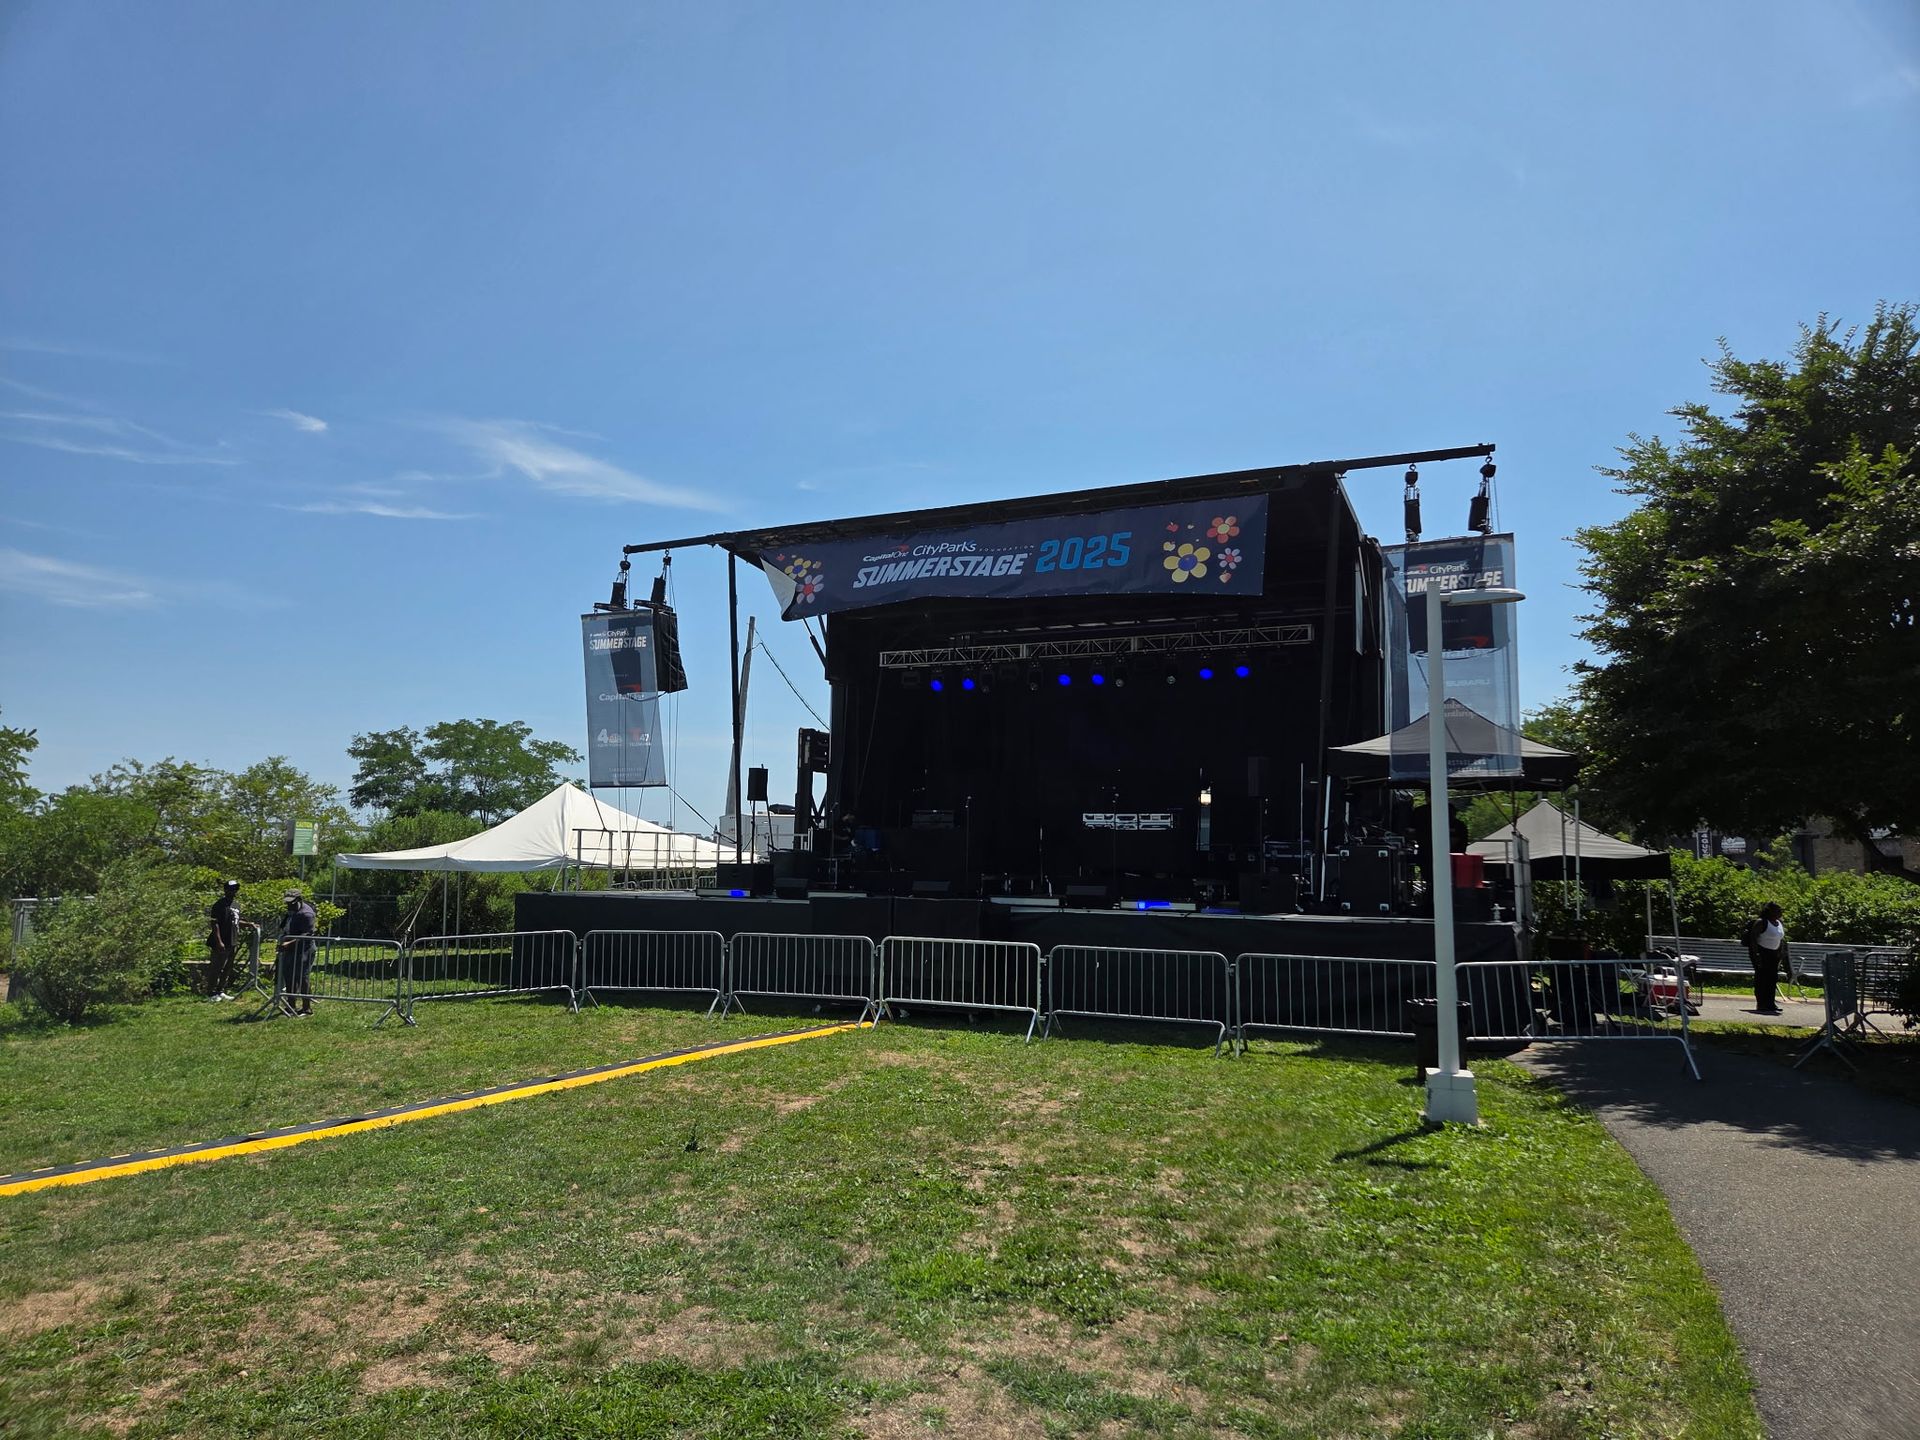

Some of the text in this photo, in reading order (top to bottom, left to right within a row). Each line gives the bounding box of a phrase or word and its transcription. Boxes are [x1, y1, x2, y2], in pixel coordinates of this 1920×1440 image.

[912, 541, 977, 556] CityParks
[1035, 532, 1132, 572] 2025
[853, 553, 1028, 588] SUMMERSTAGE
[589, 636, 647, 650] SUMMERSTAGE
